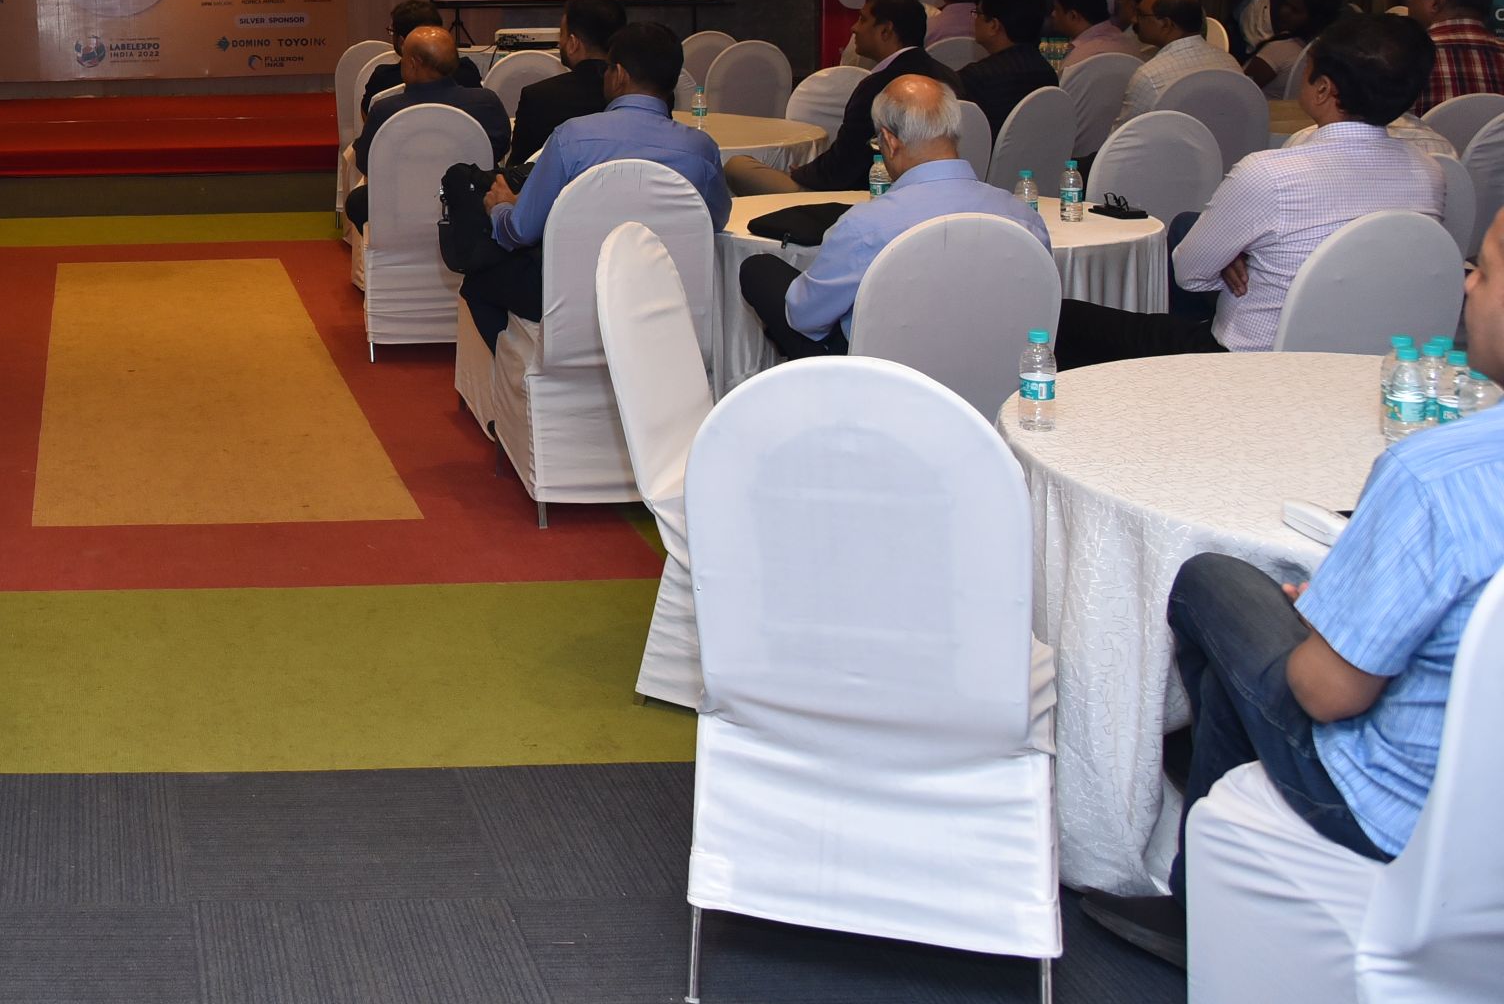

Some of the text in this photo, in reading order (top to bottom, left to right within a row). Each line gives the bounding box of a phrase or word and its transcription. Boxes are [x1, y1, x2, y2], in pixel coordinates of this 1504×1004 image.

[268, 16, 304, 24] SPONSOR
[110, 42, 160, 51] LABELEXPO
[232, 39, 271, 47] DOMINO
